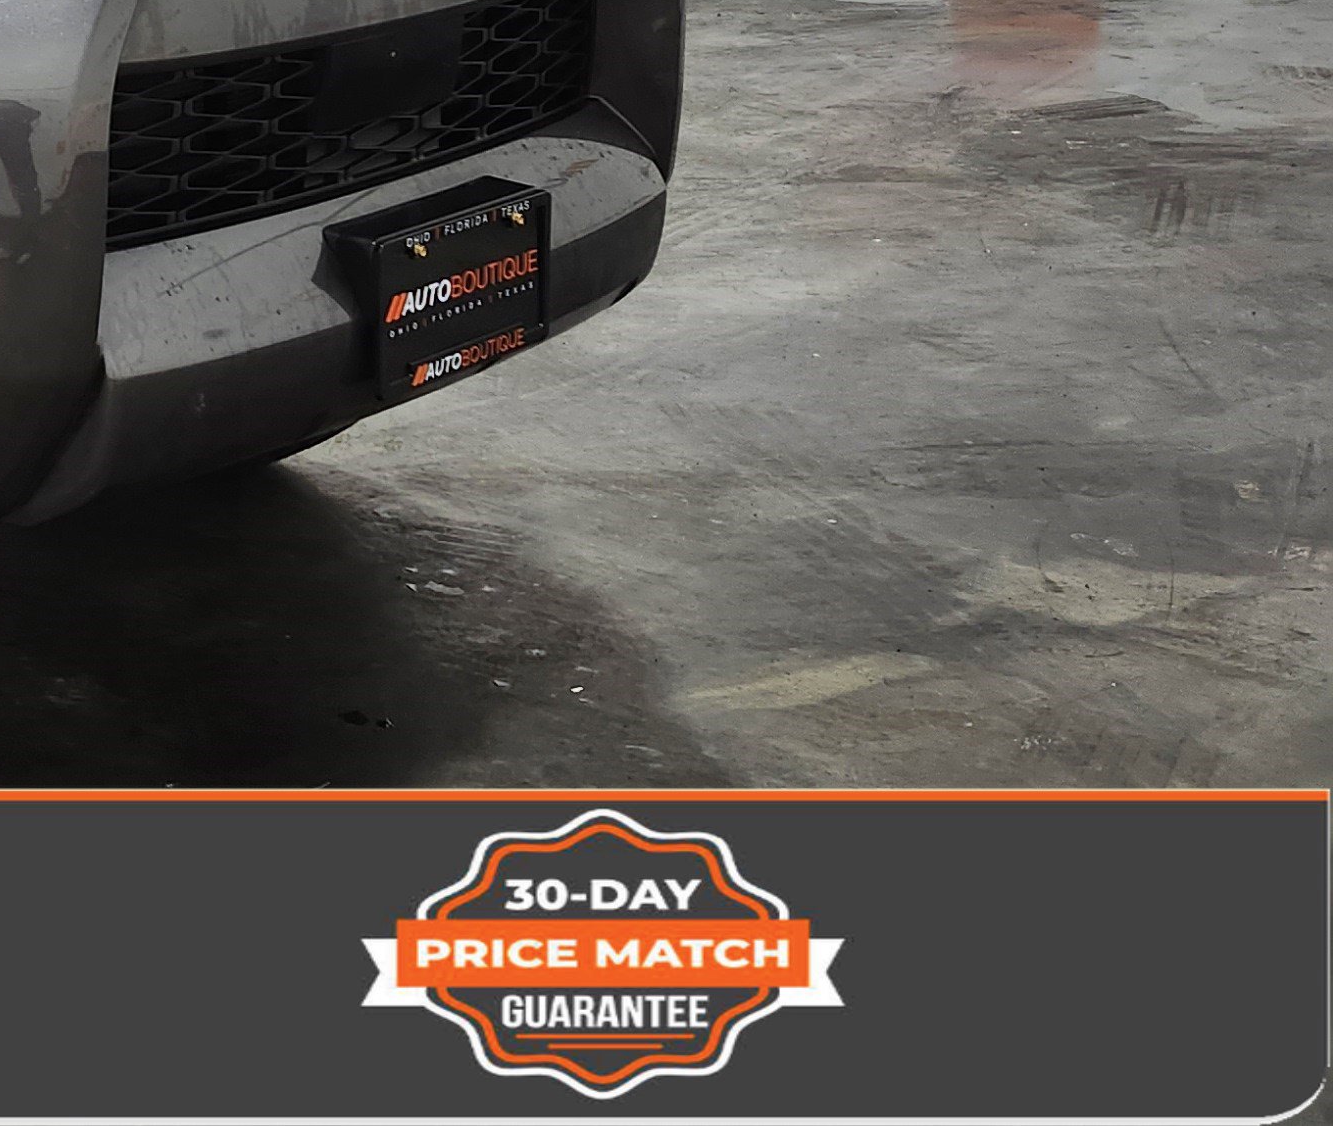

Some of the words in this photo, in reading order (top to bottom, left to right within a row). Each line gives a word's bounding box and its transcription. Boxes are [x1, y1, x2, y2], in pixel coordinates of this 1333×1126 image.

[444, 213, 489, 236] FLORIDA
[501, 200, 530, 218] TEXAS
[388, 322, 419, 338] OHIO
[431, 299, 483, 323] FLORIDA
[497, 280, 535, 299] TEXAS
[401, 248, 539, 317] AUTOBOUTIQUE
[424, 326, 526, 382] AUTOBOUTIQUE
